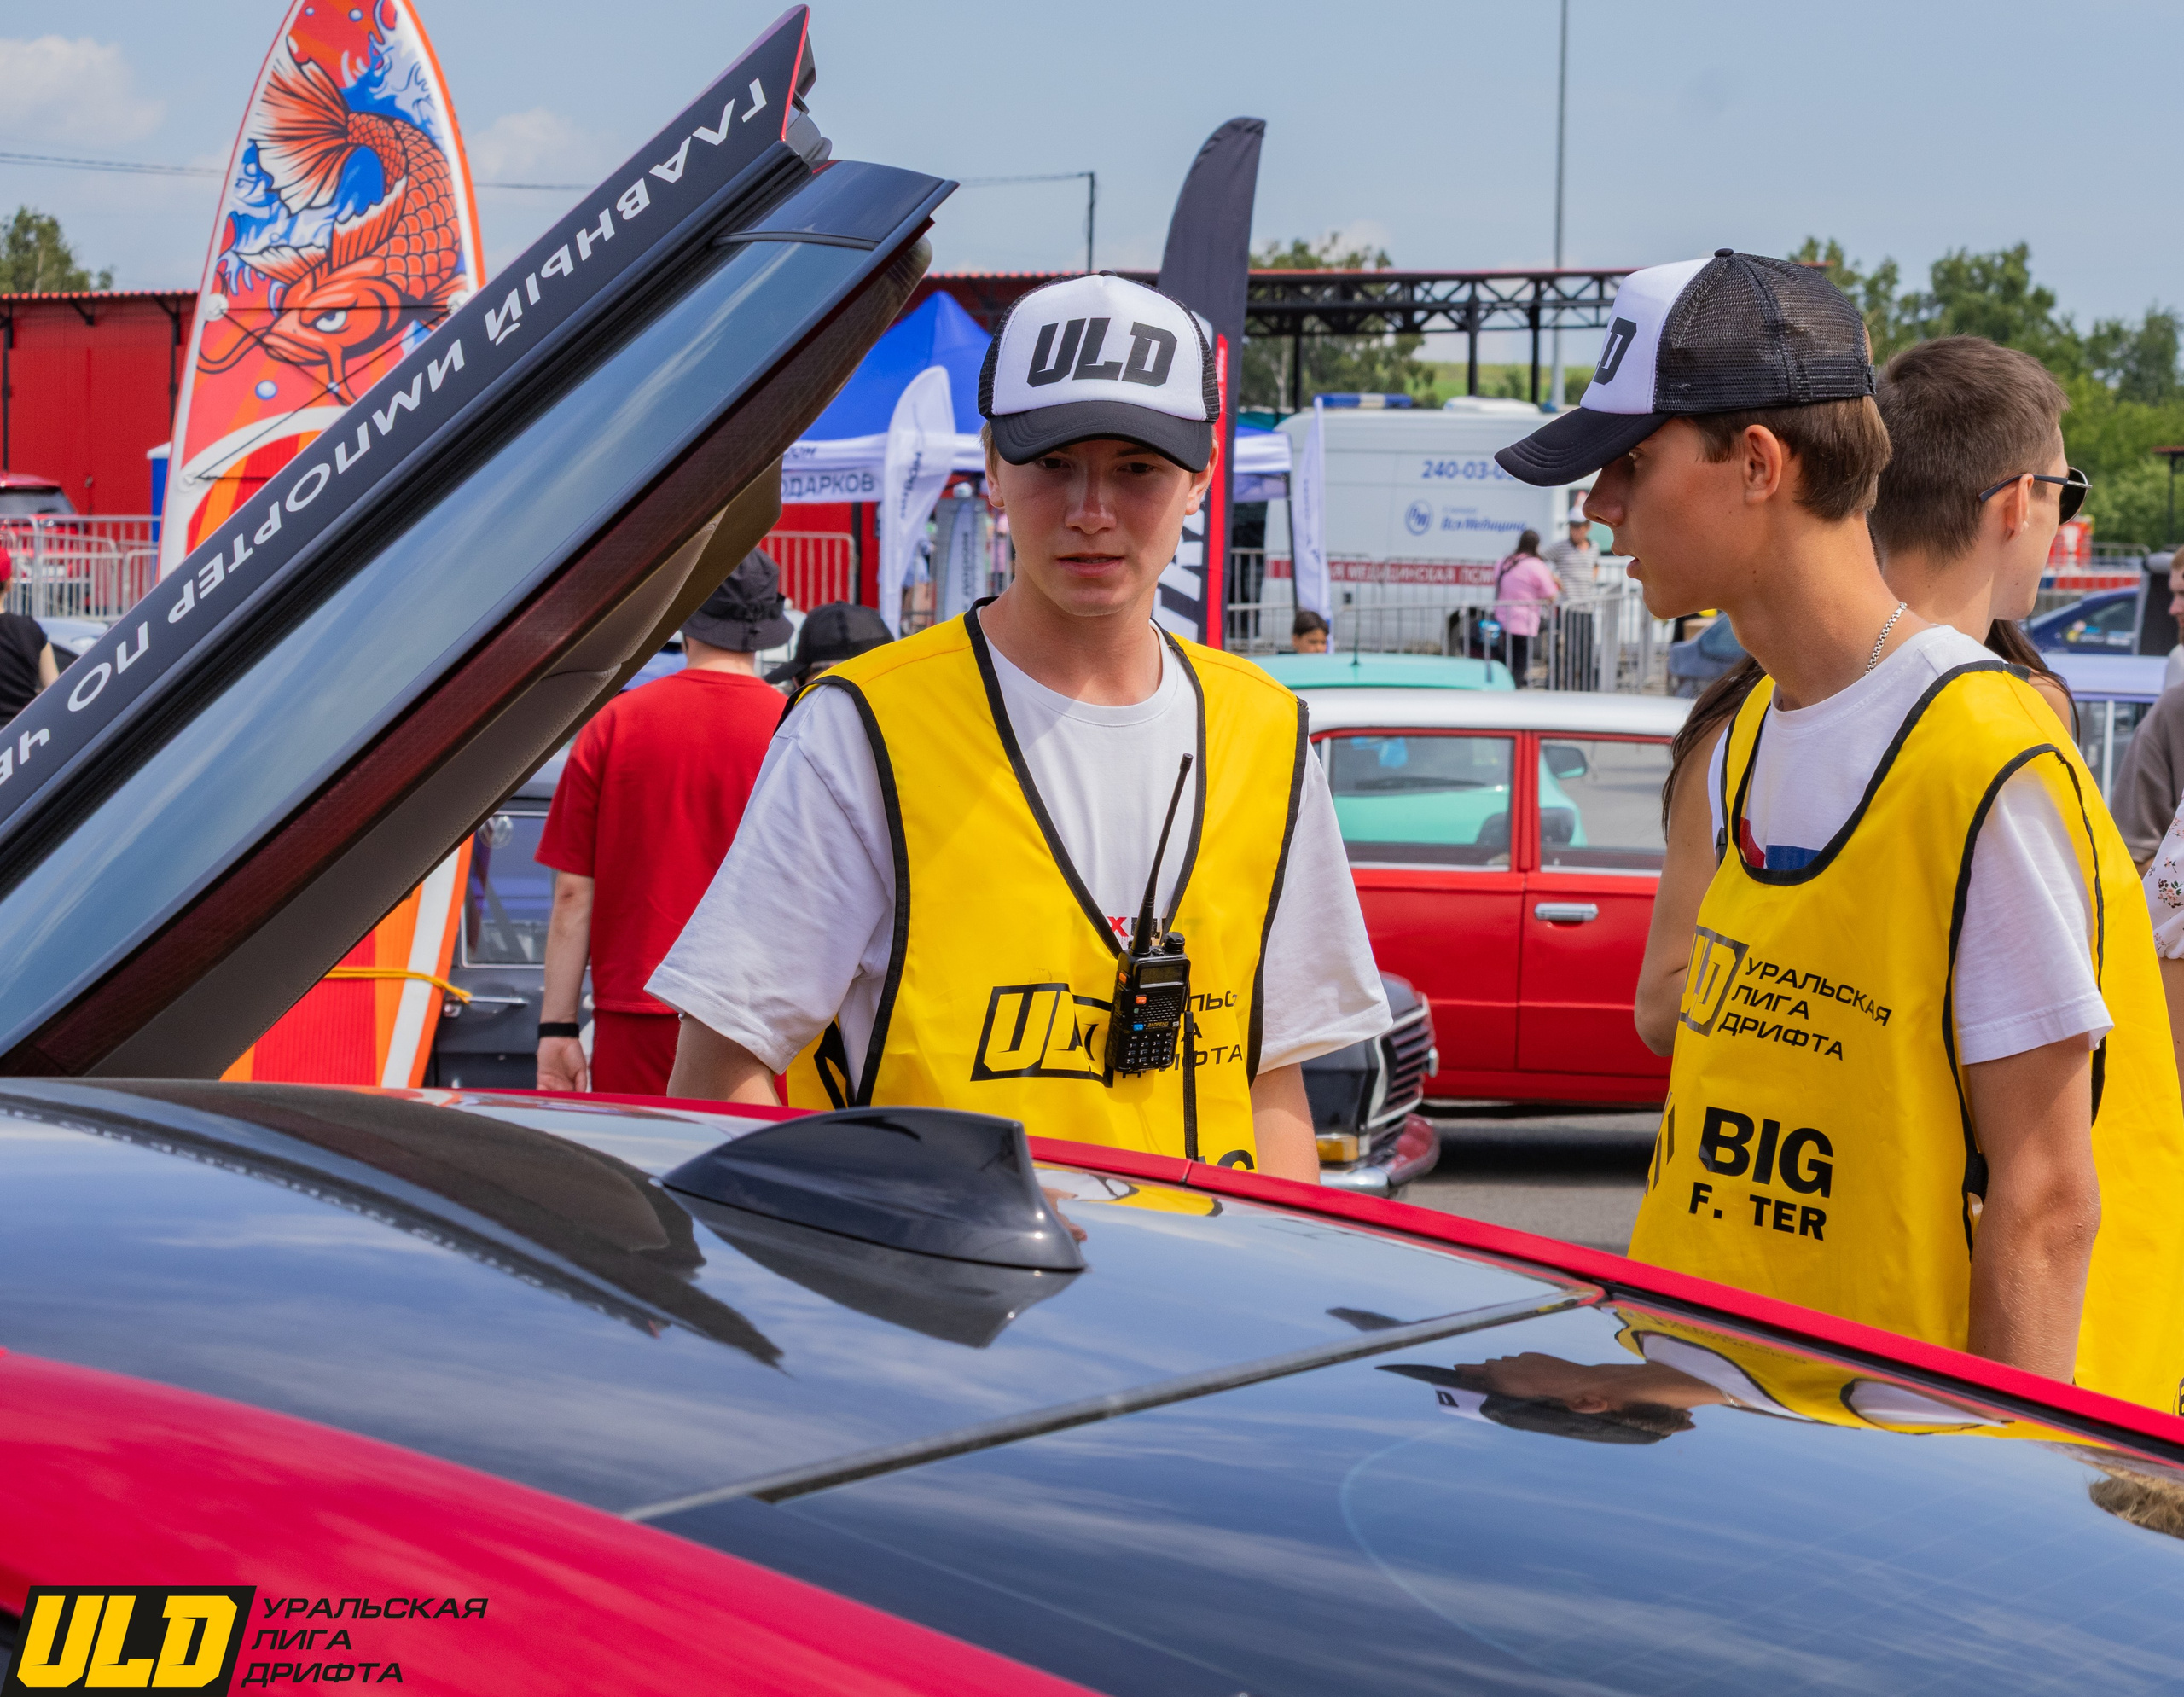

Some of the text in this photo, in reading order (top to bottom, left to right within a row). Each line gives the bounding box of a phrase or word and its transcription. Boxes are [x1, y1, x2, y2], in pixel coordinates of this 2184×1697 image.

[485, 78, 767, 346] ГЛАВНЫЙ
[1027, 317, 1177, 388] ULD
[168, 338, 465, 624] ИМПОРТЕР
[1421, 459, 1517, 481] 240-03-0
[67, 623, 149, 712] ПО
[1731, 984, 1810, 1020] ЛИГА
[1745, 956, 1892, 1027] УРАЛЬСКАЯ
[1717, 1012, 1844, 1061] ДРИФТА
[1699, 1106, 1834, 1199] BIG
[1749, 1194, 1827, 1241] TER
